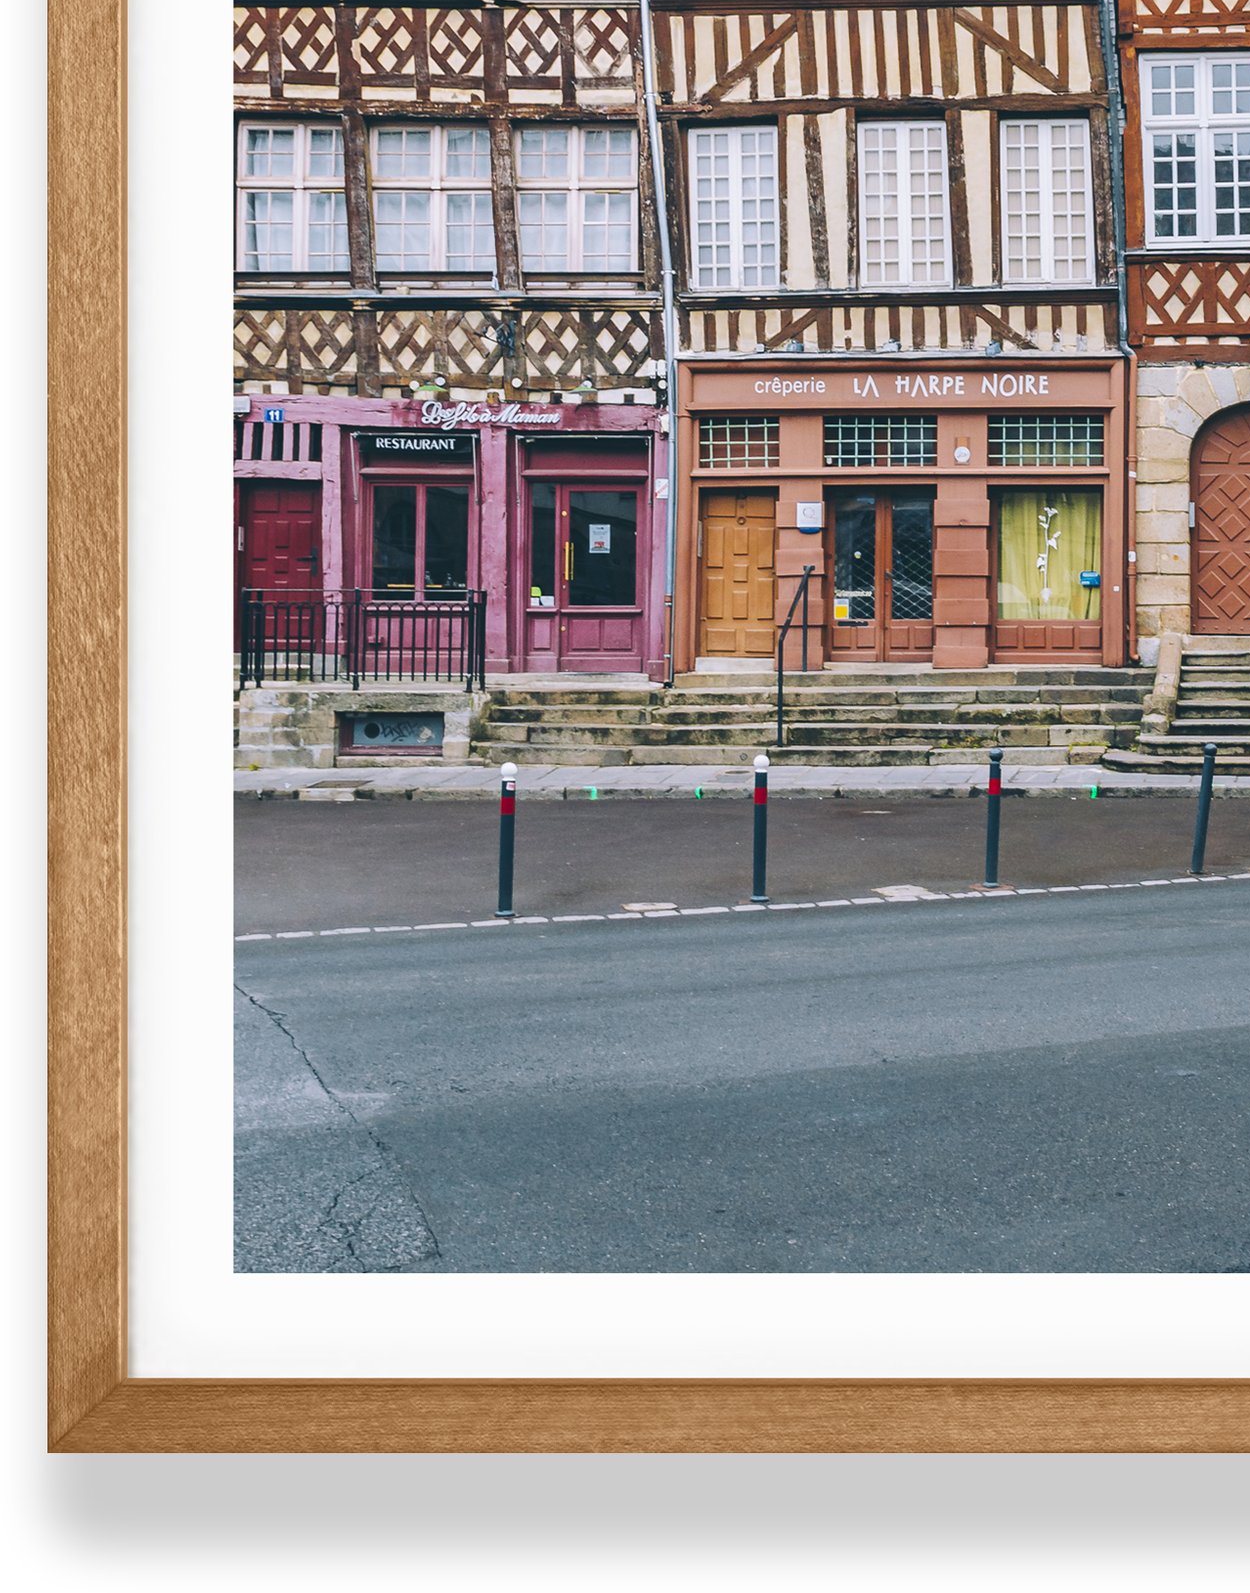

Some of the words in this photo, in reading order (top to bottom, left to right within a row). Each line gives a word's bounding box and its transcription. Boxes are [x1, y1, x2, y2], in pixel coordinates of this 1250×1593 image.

[754, 376, 826, 397] crêperie
[853, 375, 880, 397] LA
[895, 375, 965, 398] HARPE
[981, 373, 1049, 397] NOIRE
[268, 410, 280, 421] 11
[479, 408, 492, 423] à
[490, 404, 561, 424] Maman
[375, 437, 456, 450] RESTAURANT
